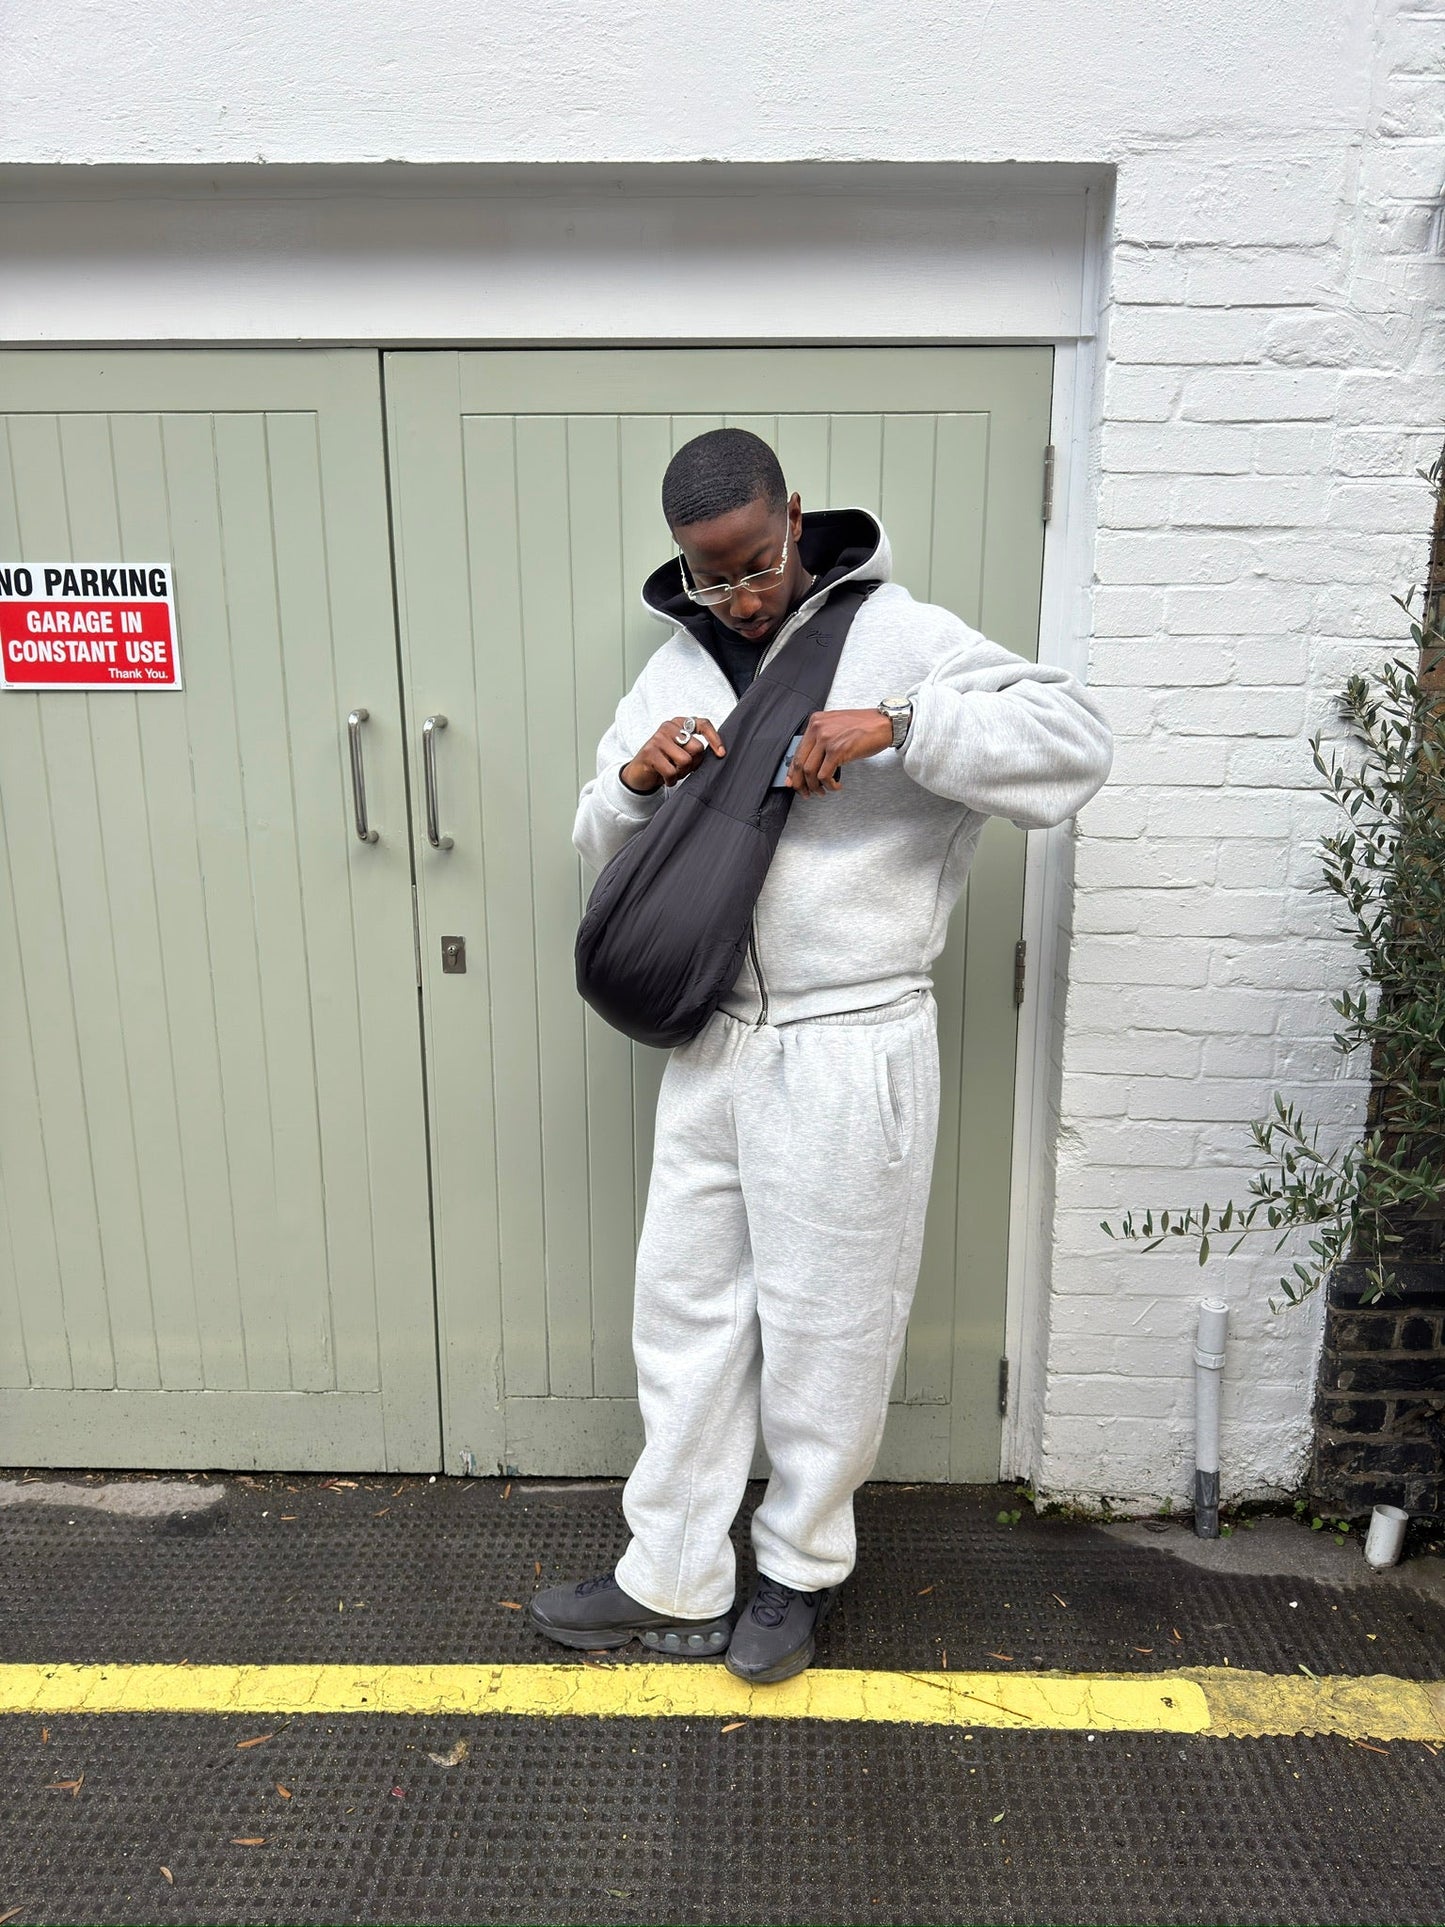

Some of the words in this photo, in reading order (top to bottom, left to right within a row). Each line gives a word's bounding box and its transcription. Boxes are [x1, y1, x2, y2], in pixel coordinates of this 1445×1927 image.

[0, 568, 33, 597] NO
[44, 568, 168, 597] PARKING
[26, 610, 114, 633] GARAGE
[120, 611, 143, 633] IN
[8, 640, 118, 663] CONSTANT
[125, 641, 167, 663] USE
[108, 668, 142, 679] Thank
[145, 668, 168, 679] You.
